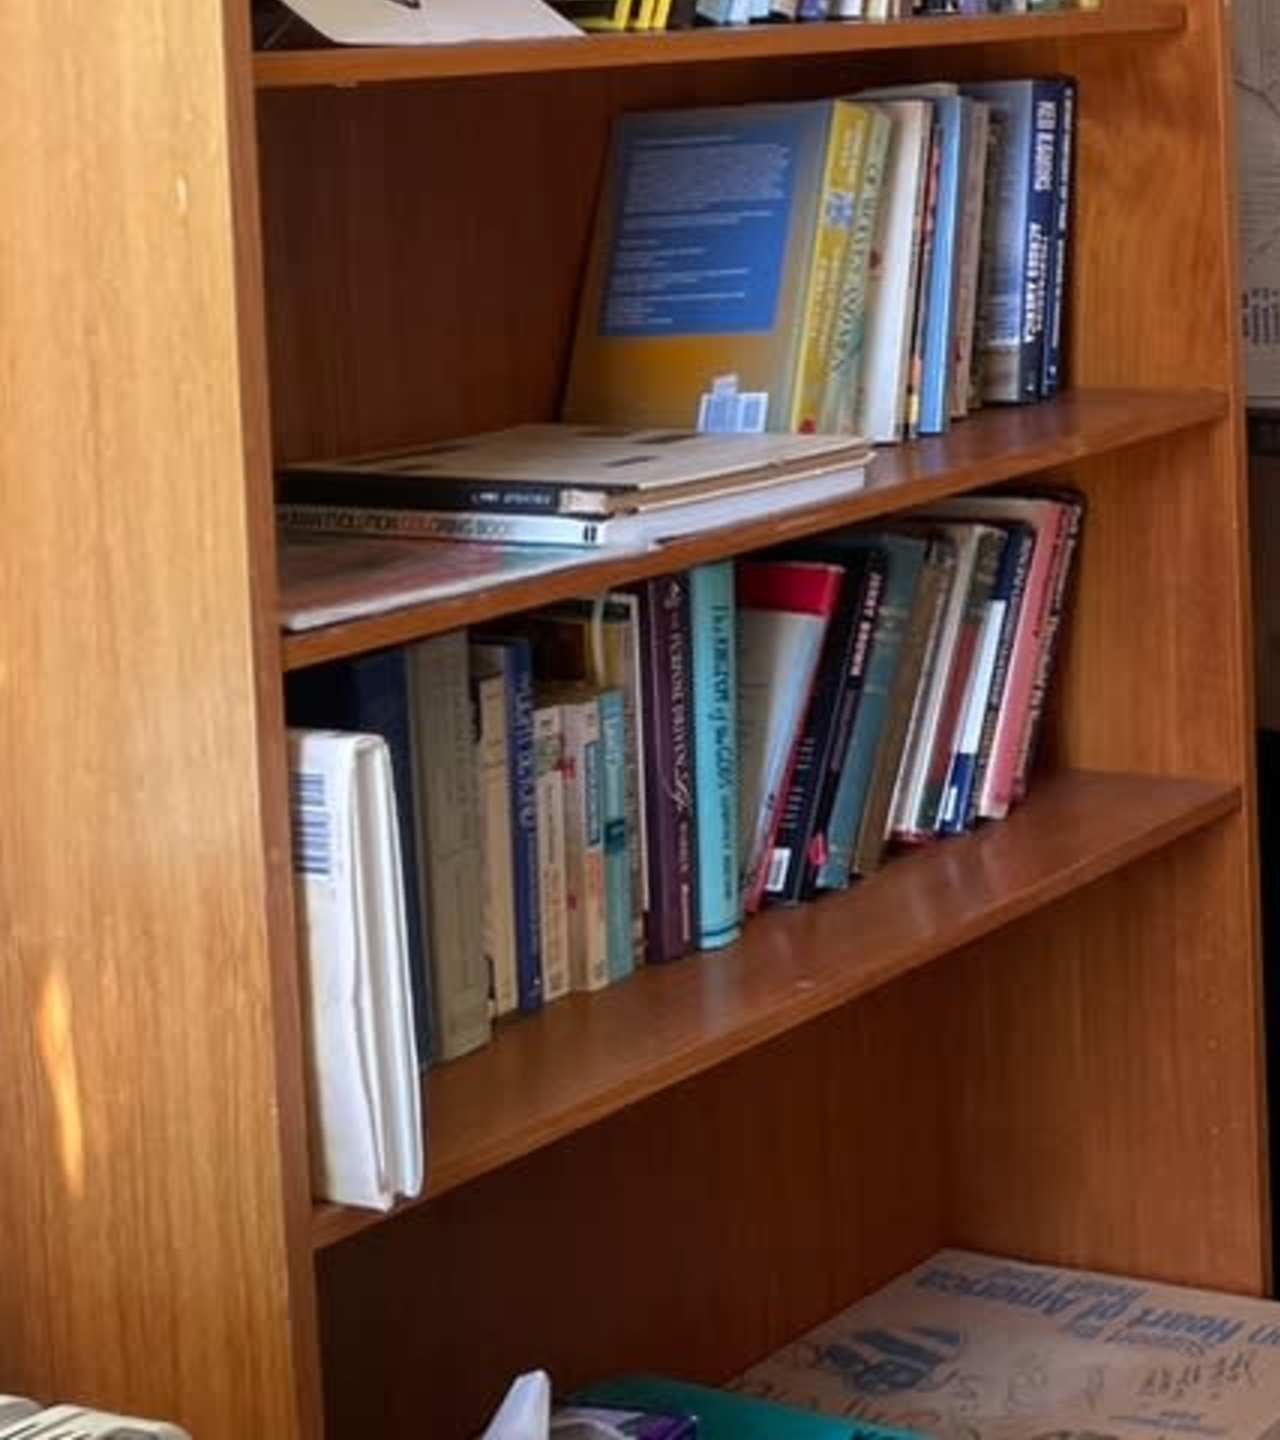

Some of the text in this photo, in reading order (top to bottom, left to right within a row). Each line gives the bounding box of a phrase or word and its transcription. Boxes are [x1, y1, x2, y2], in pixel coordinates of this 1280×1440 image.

[1023, 281, 1039, 344] AMERICA
[912, 1267, 1071, 1317] America
[1072, 1291, 1132, 1329] of
[1135, 1304, 1243, 1346] Heart
